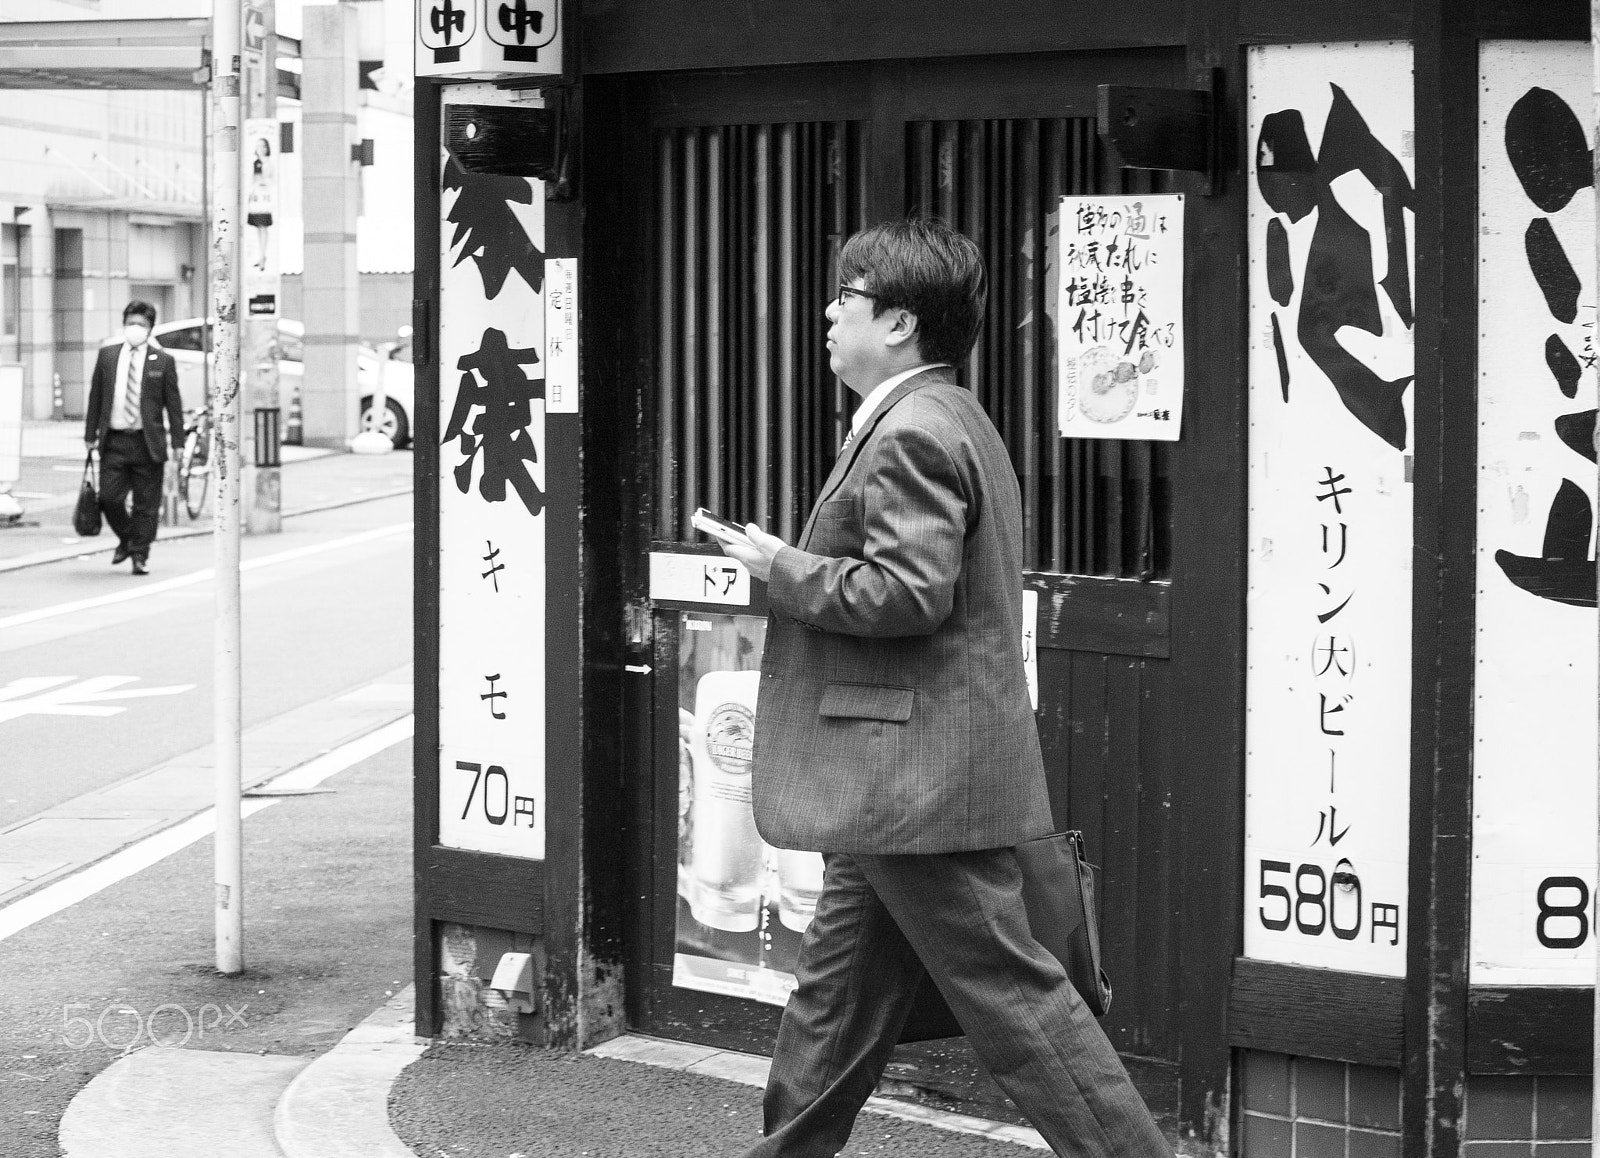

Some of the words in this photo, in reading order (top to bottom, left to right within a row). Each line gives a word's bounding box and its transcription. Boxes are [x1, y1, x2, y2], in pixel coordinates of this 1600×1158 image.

[549, 289, 563, 403] 定休日
[480, 540, 508, 720] キモ
[456, 760, 535, 829] 70円
[1259, 857, 1399, 947] 580円
[1537, 876, 1597, 949] 8
